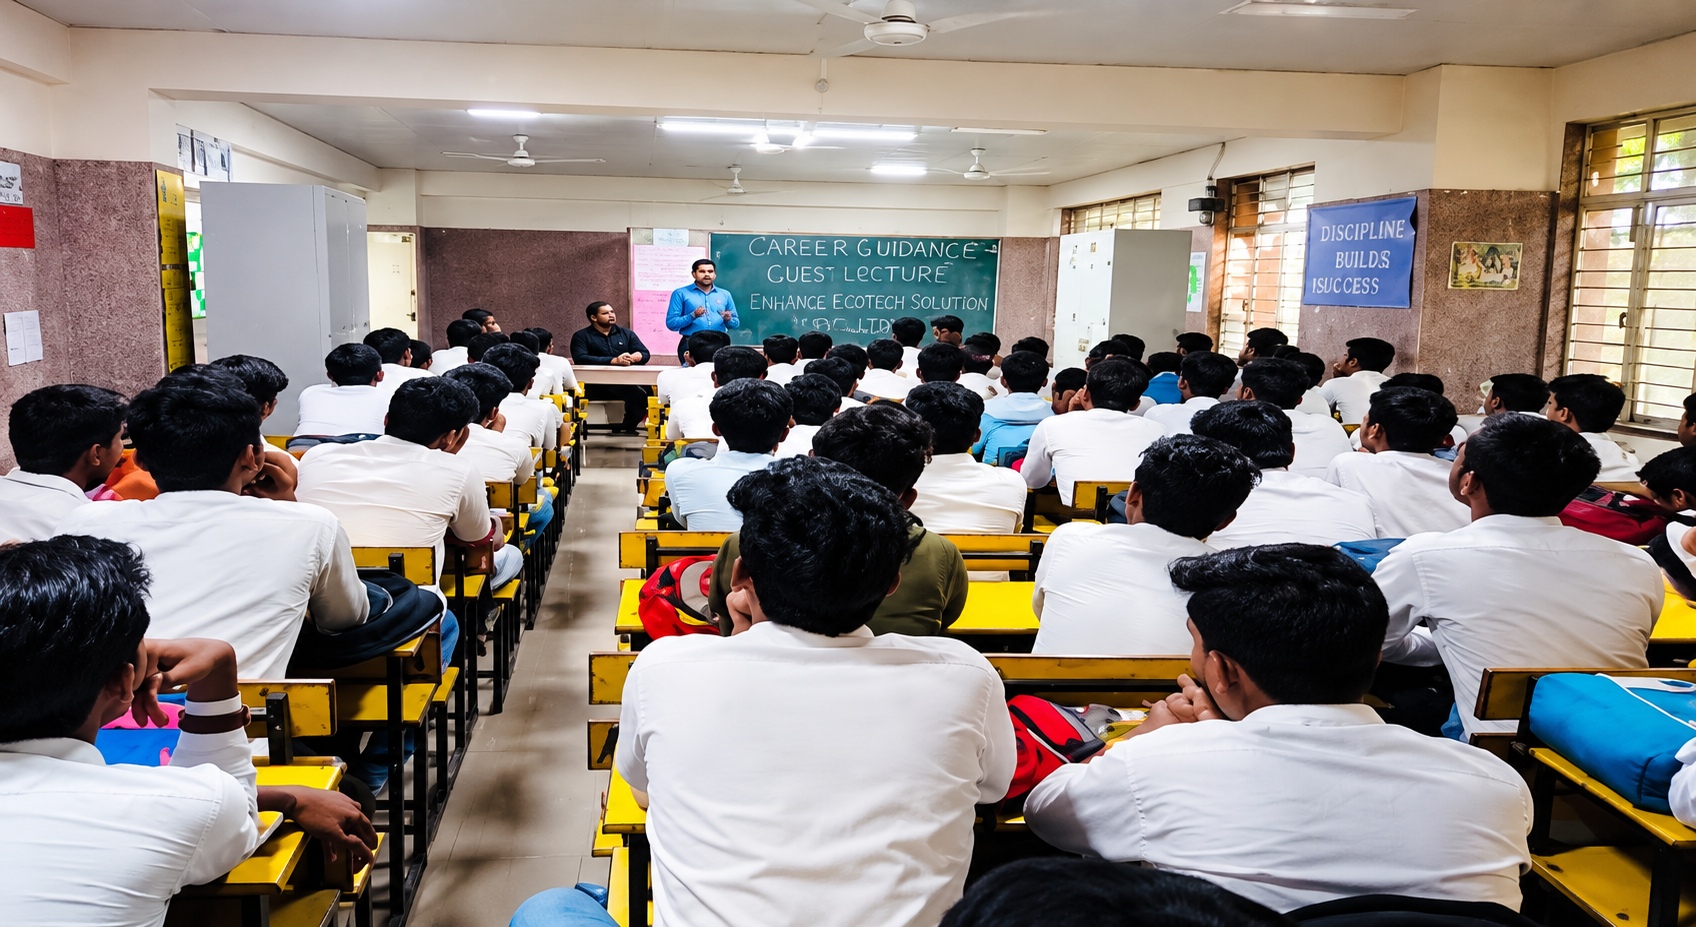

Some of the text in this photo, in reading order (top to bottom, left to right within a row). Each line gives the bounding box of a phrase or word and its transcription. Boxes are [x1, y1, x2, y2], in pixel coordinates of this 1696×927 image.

[1320, 220, 1405, 242] DISCIPLINE
[748, 236, 977, 259] CAREER GUIDANCE
[767, 264, 835, 283] GUEST
[750, 293, 826, 311] ENHANCE
[833, 293, 903, 311] ECOTECH
